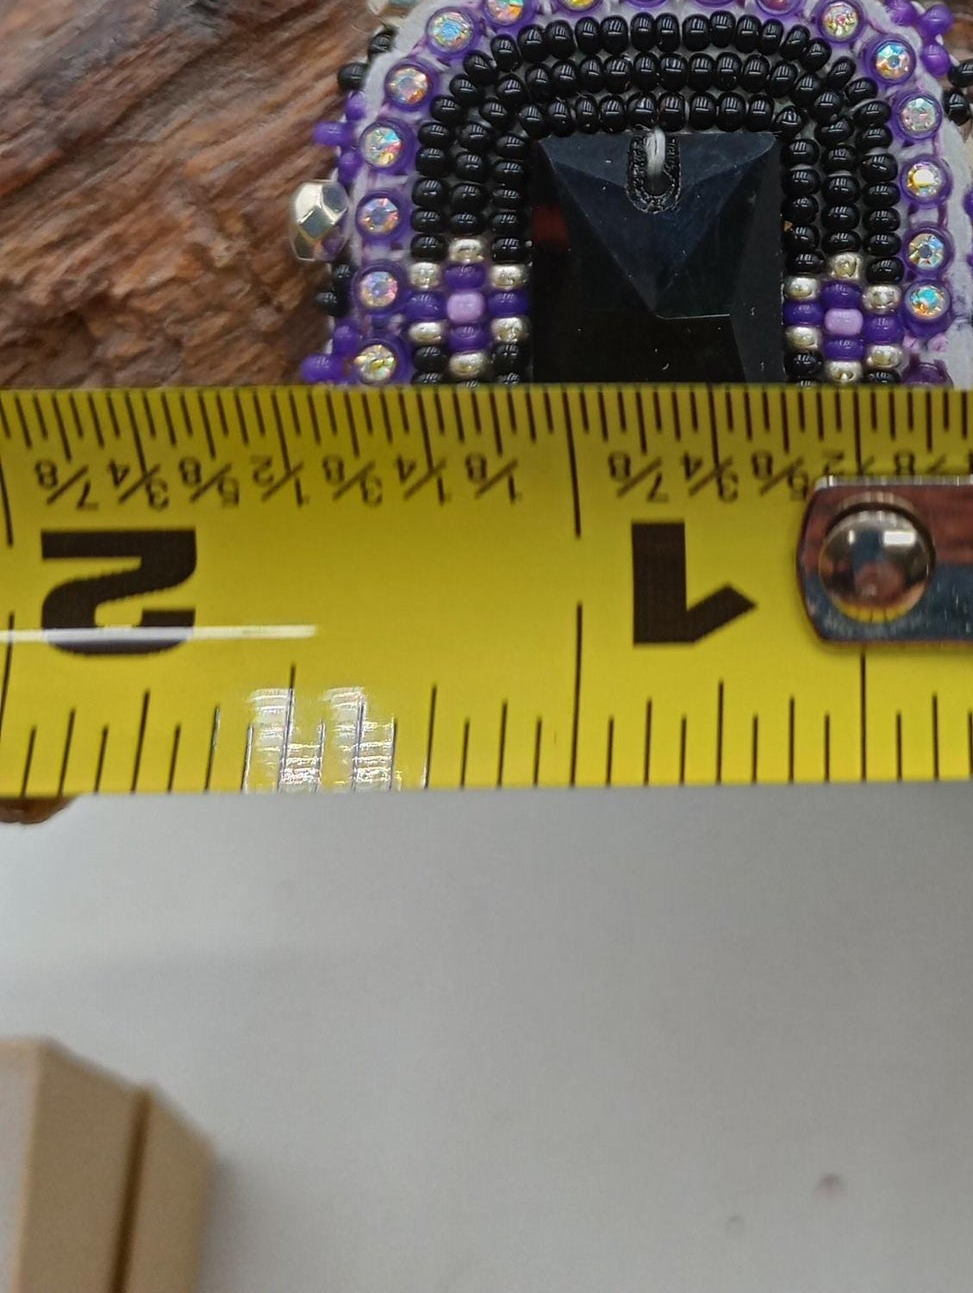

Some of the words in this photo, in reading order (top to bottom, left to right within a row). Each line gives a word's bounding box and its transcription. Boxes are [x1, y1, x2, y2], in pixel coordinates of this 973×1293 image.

[34, 461, 98, 512] 7/8
[108, 460, 169, 511] 3/4
[179, 457, 240, 508] 5/8
[250, 456, 309, 508] 1/2
[323, 455, 382, 507] 3/8
[389, 454, 447, 505] 1/4
[465, 454, 521, 504] 1/8
[608, 454, 668, 503] 7/8
[682, 452, 738, 503] 3/4
[751, 452, 809, 502] 5/8
[39, 526, 197, 659] 2
[631, 520, 757, 647] 1
